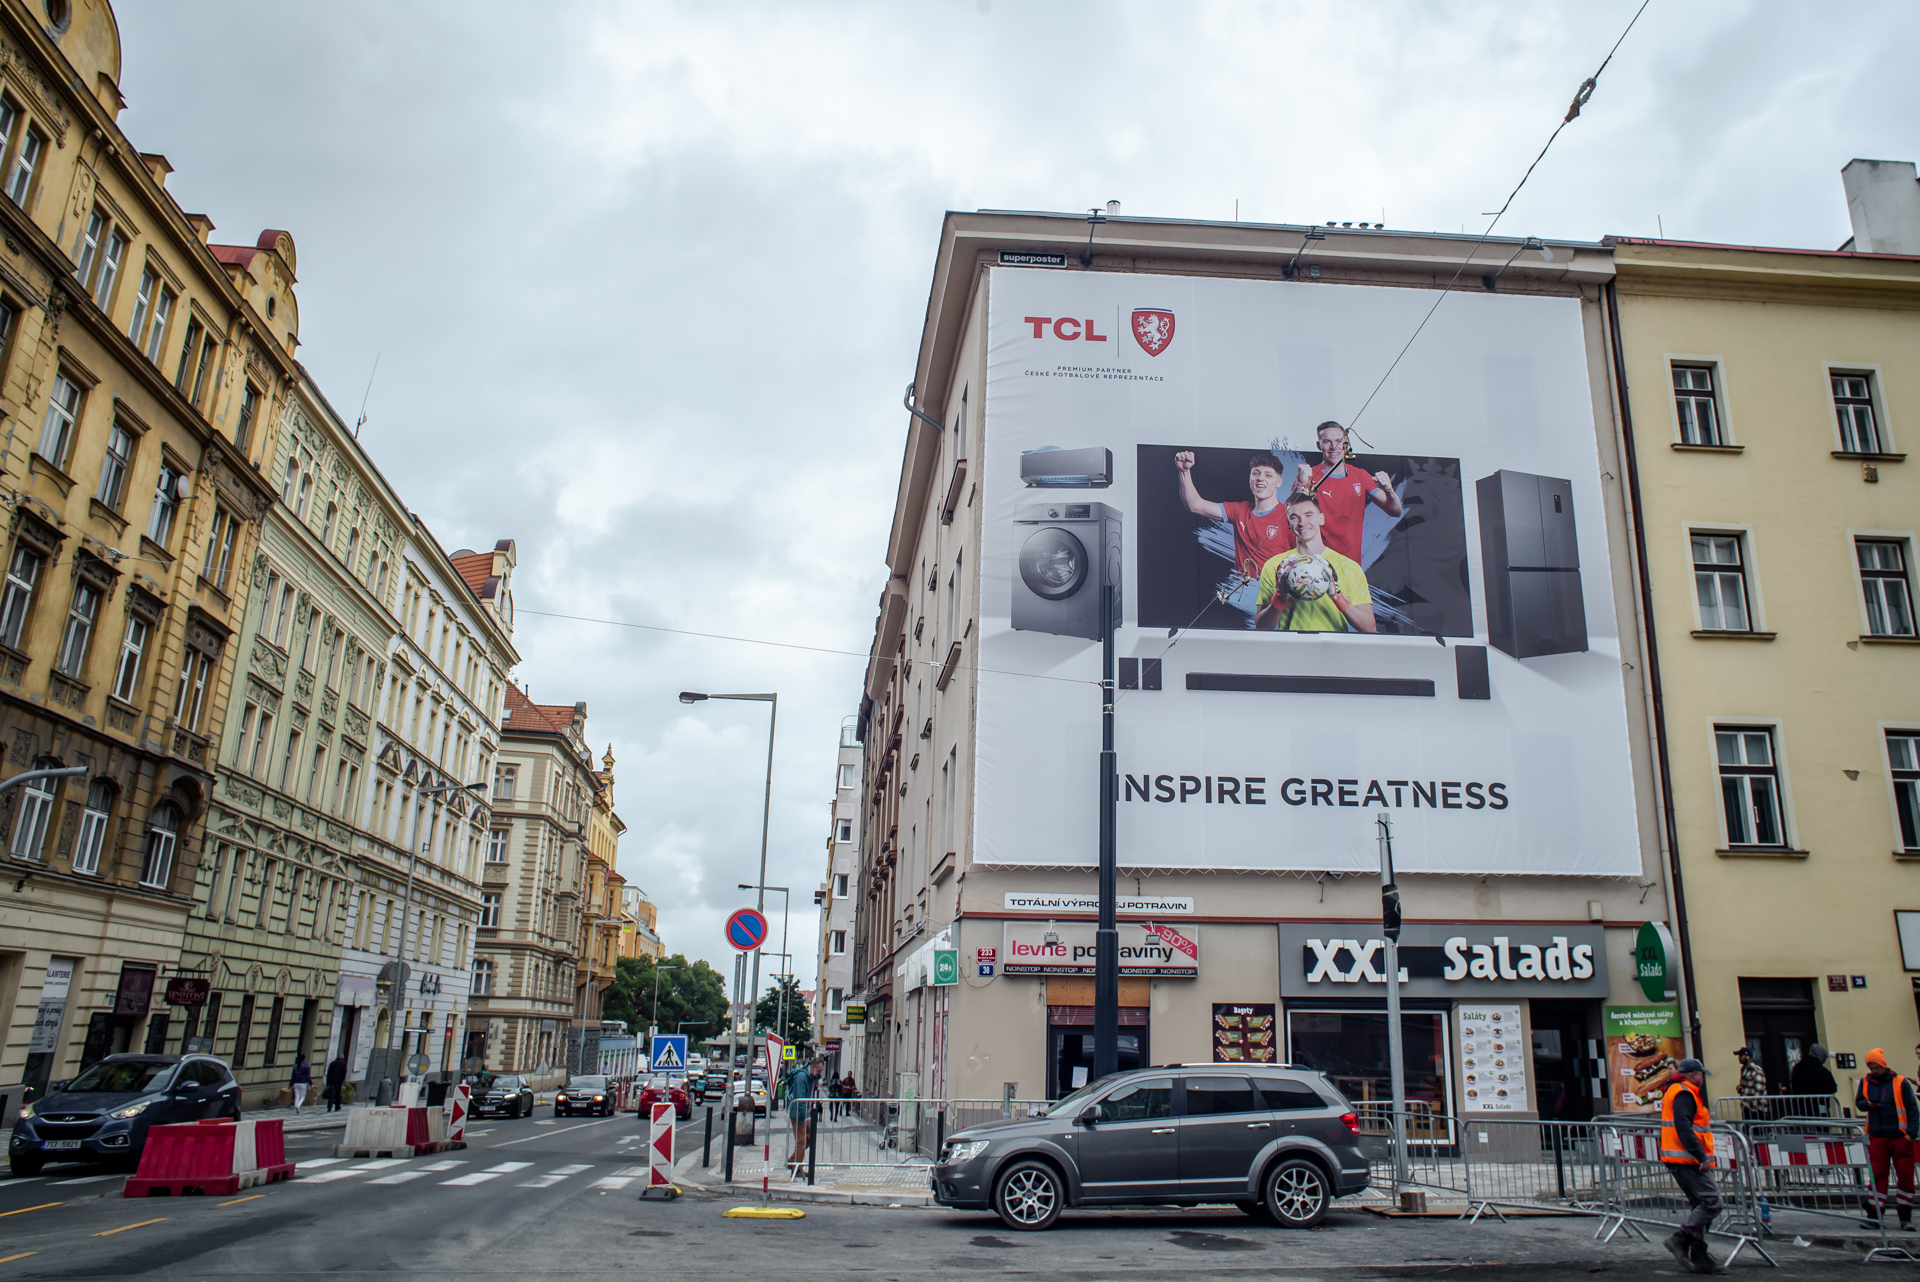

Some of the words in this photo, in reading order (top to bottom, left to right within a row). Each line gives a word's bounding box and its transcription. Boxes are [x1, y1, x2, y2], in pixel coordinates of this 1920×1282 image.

[1003, 254, 1062, 264] superposter
[1024, 316, 1107, 342] TCL
[1053, 371, 1100, 379] FOTBALOVÉ
[1103, 374, 1164, 382] REPREZENTACE
[1280, 777, 1510, 810] GREATNESS
[1010, 897, 1060, 907] TOTÁLNÍ
[1062, 898, 1125, 909] VÝPROJ
[1127, 902, 1187, 910] POTRAVIN
[980, 948, 993, 957] 233
[1012, 940, 1067, 956] levné
[1073, 945, 1174, 963] poaviny
[1640, 946, 1658, 961] XXL
[1443, 936, 1594, 982] Salads
[1640, 963, 1663, 977] Salads
[1233, 1006, 1254, 1015] Bagety
[1462, 1011, 1487, 1021] Saláty
[1656, 1010, 1674, 1018] saláty
